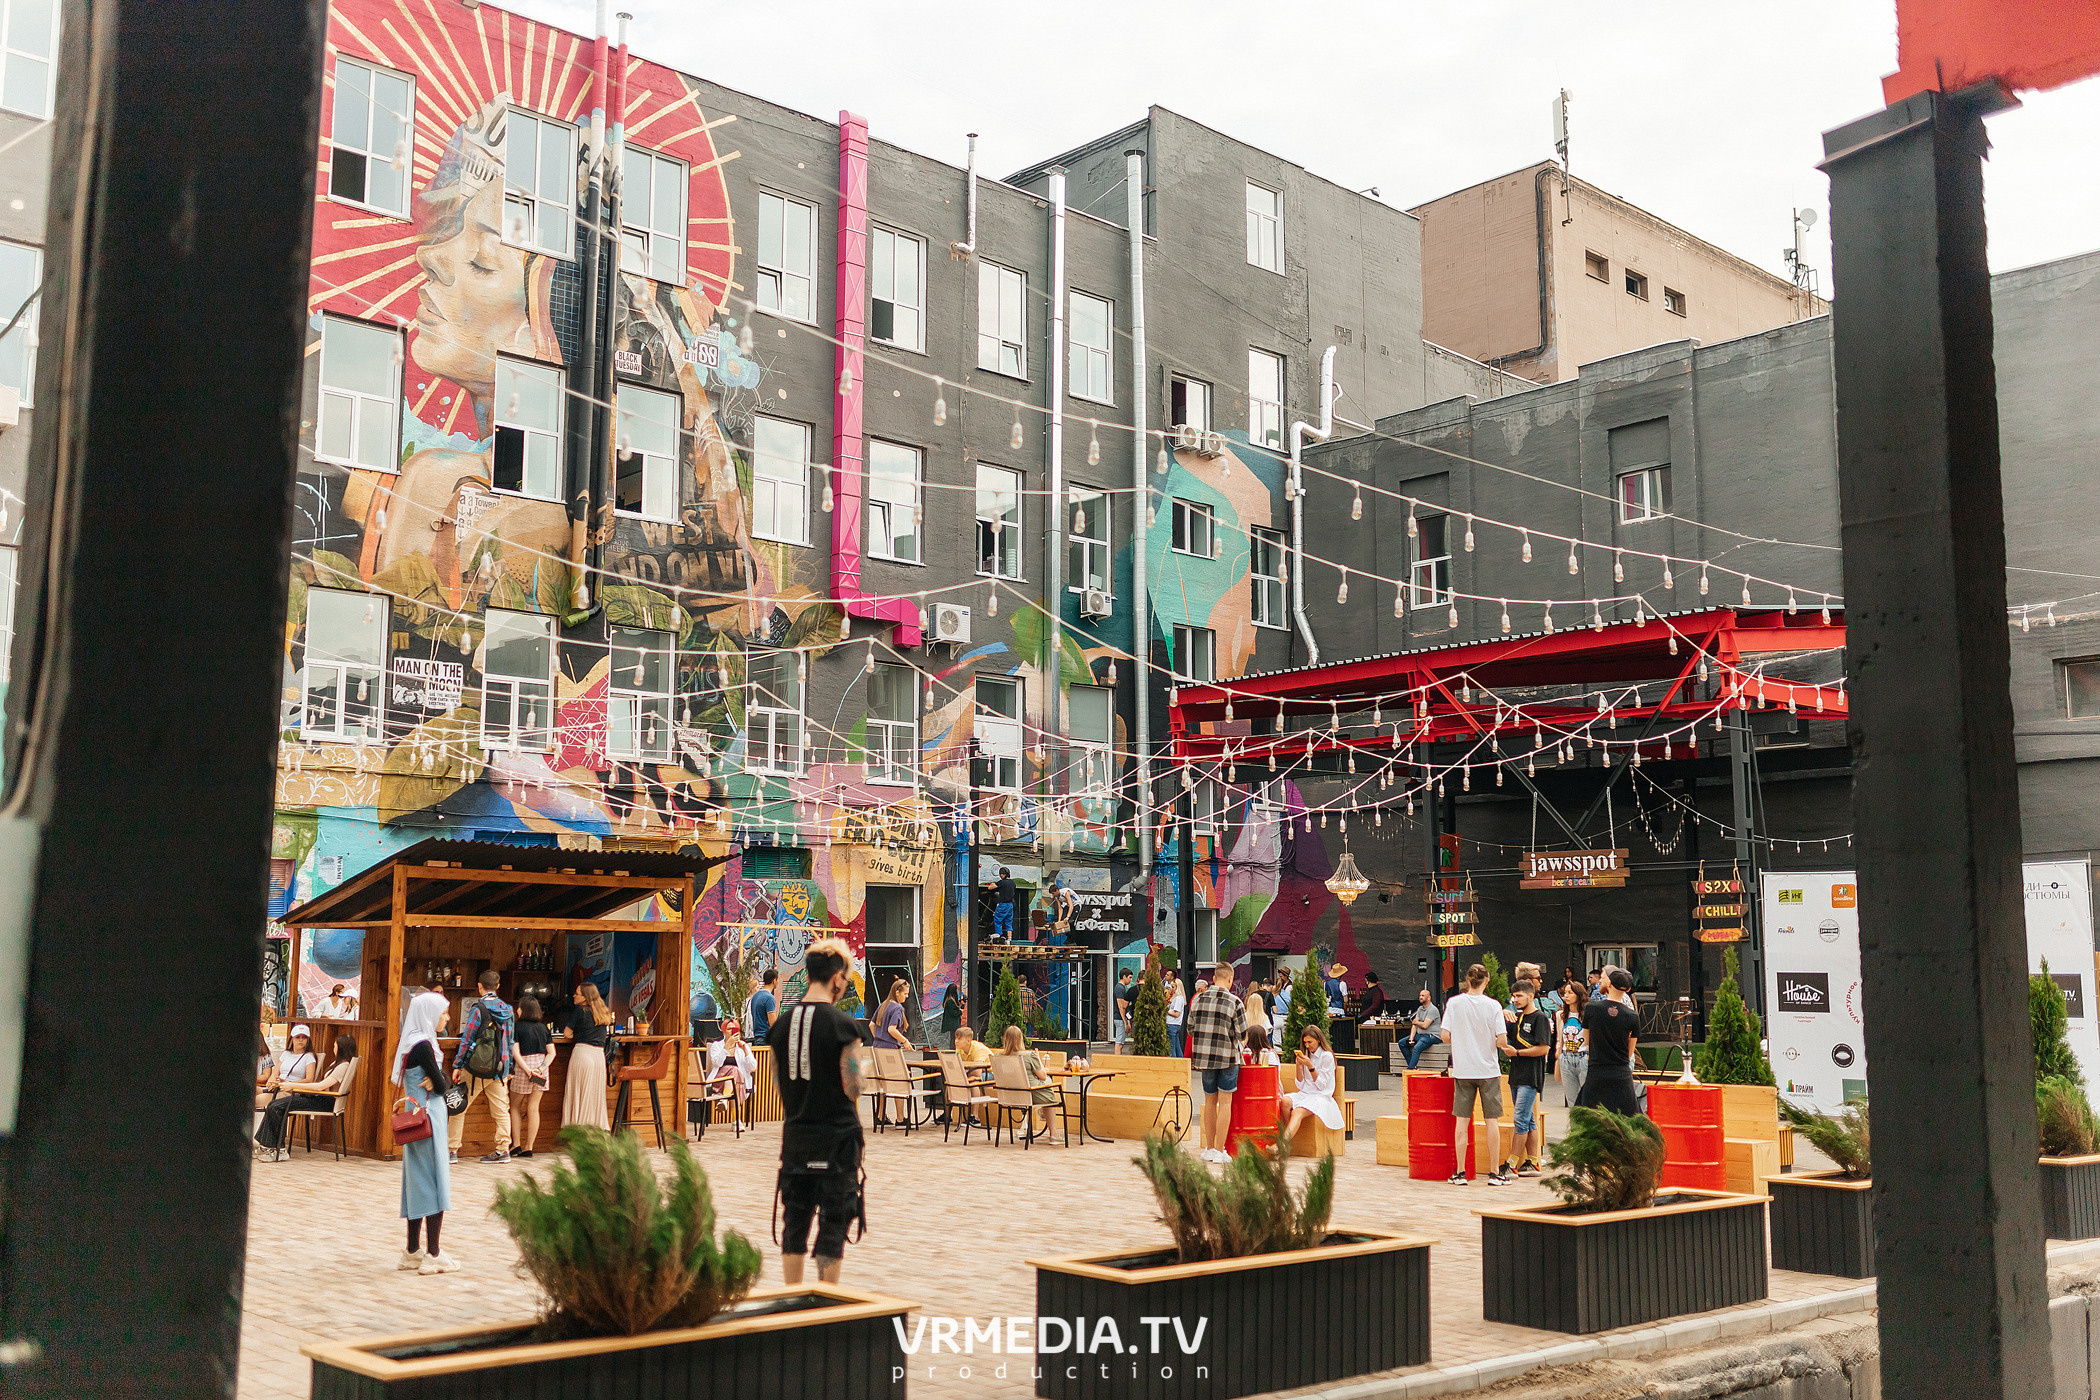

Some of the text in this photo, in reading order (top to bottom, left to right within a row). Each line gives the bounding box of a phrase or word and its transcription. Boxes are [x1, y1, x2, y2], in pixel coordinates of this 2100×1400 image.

[618, 352, 638, 362] BLACK
[615, 360, 641, 372] TUESDAY
[641, 509, 713, 548] WEST
[667, 551, 711, 590] ON
[396, 659, 462, 678] MAN ON THE
[428, 677, 460, 692] MOON
[868, 857, 923, 884] gives birth
[1529, 851, 1618, 878] jawsspot
[2023, 883, 2041, 891] ДИ
[1436, 890, 1465, 903] surf
[1438, 913, 1466, 923] SPOT
[1440, 934, 1473, 946] BEER
[1783, 979, 1821, 1002] House
[2063, 989, 2076, 998] TV
[1795, 1083, 1814, 1093] ПРАЙМ
